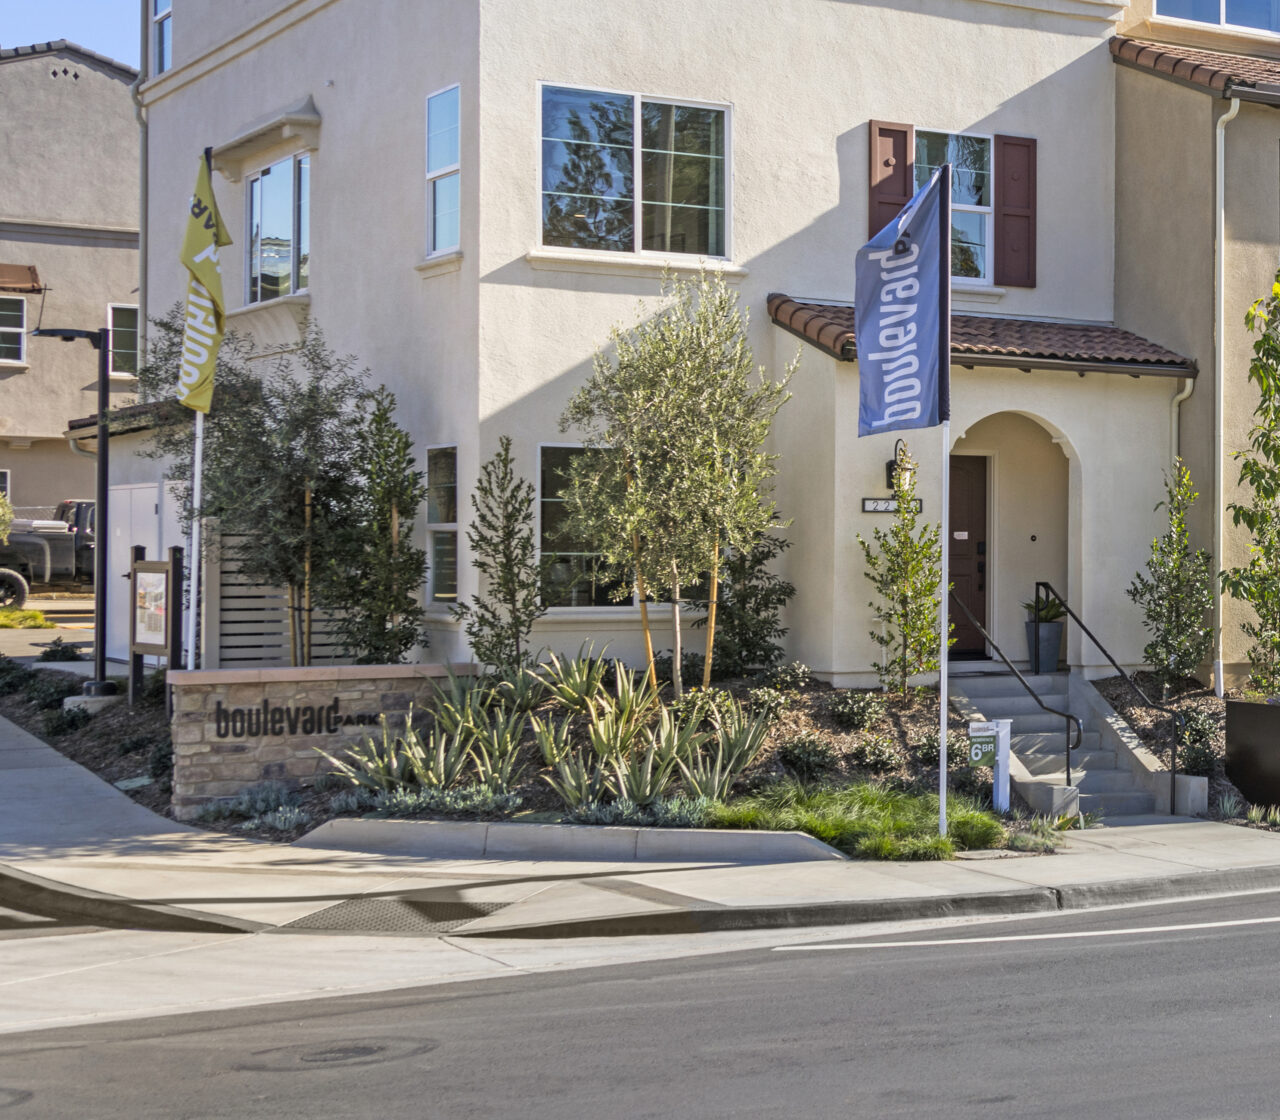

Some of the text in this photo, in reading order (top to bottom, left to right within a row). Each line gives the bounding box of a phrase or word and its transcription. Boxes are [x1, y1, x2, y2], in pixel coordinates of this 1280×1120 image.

[868, 243, 922, 428] boulevard
[216, 696, 380, 738] boulevard PARK
